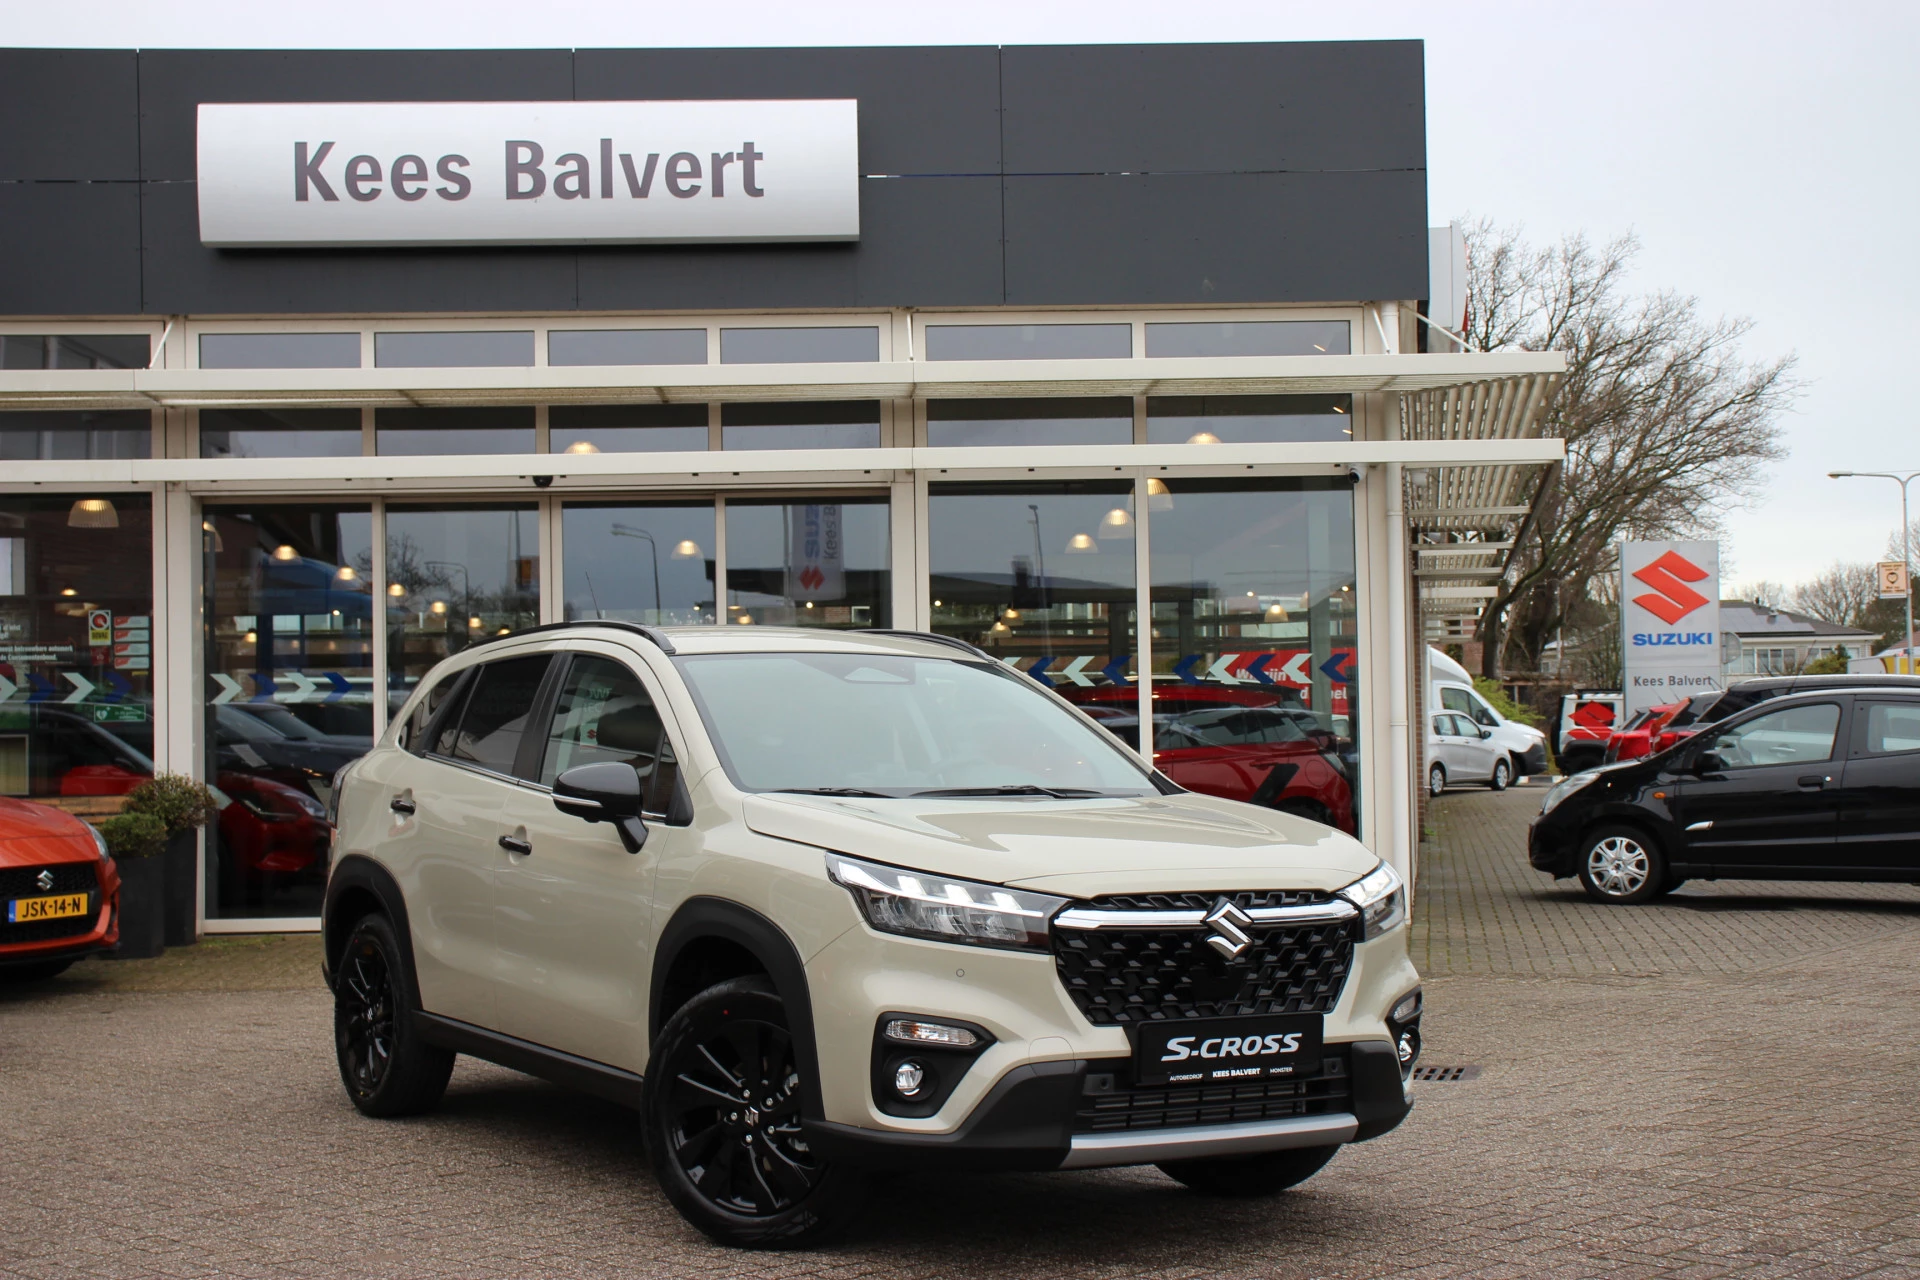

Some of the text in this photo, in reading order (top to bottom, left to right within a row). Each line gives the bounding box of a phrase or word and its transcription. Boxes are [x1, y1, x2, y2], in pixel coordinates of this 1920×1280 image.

[294, 138, 764, 202] Kees Balvert
[823, 520, 838, 559] Kees
[1632, 633, 1712, 646] SUZUKI
[1633, 674, 1712, 687] Kees Balvert
[22, 897, 81, 918] JSK-14-N
[1161, 1032, 1303, 1061] S-CROSS
[1212, 1070, 1230, 1079] KEES
[1231, 1067, 1261, 1077] BALVERT
[1269, 1066, 1293, 1074] MONSTER
